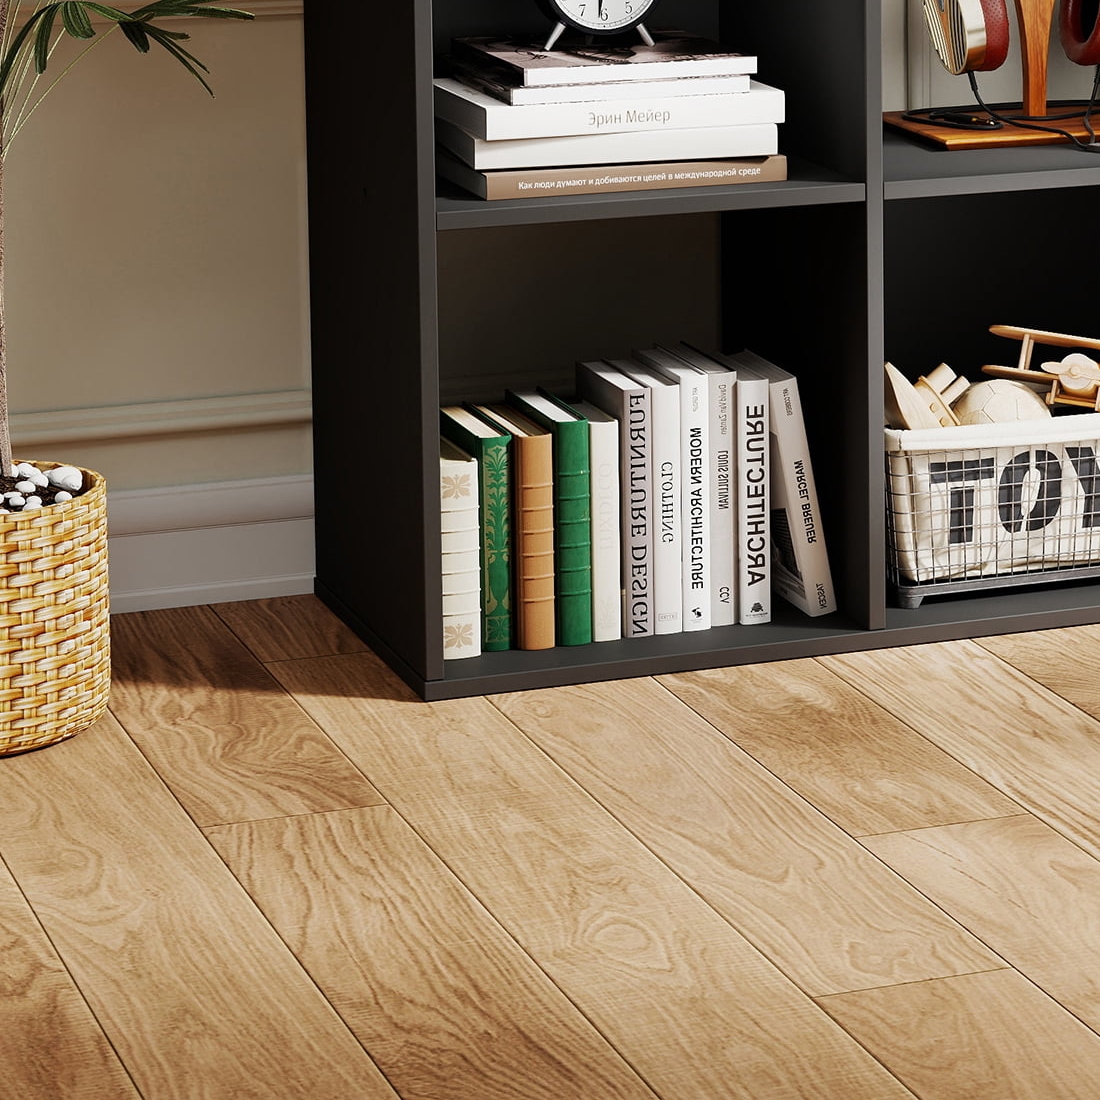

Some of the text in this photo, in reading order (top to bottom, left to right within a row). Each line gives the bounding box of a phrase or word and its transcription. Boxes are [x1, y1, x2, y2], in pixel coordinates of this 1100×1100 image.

[579, 4, 586, 17] 7
[625, 1, 633, 14] 5
[600, 8, 609, 21] 6
[588, 108, 671, 128] Эрин Мейер
[518, 181, 533, 190] Как
[533, 180, 556, 189] люди
[556, 179, 587, 188] думают
[595, 175, 642, 185] добиваются
[643, 172, 667, 182] целей
[674, 168, 737, 180] международной
[738, 167, 761, 177] среде
